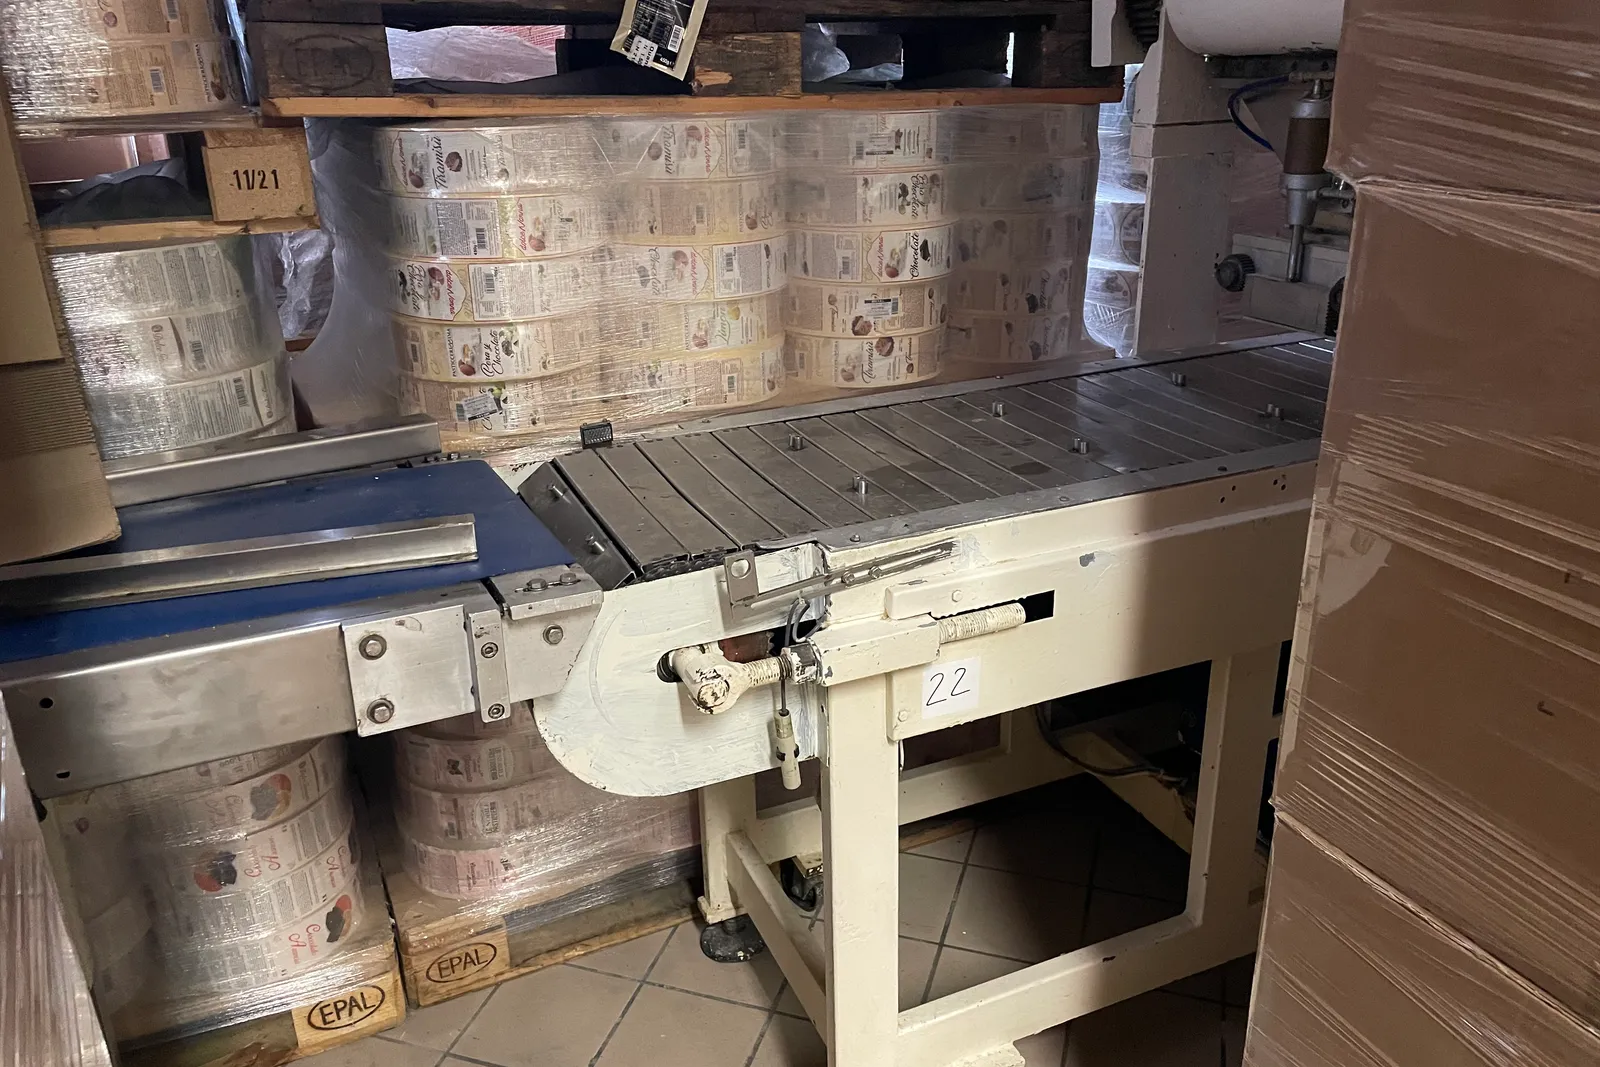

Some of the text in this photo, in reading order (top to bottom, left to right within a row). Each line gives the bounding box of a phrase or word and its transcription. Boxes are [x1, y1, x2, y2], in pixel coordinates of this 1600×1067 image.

[232, 168, 281, 192] 11/21
[909, 230, 920, 280] Chocolate
[489, 329, 504, 375] Chocolate
[925, 667, 971, 707] 22
[436, 947, 491, 981] EPAL
[318, 991, 377, 1026] EPAL
